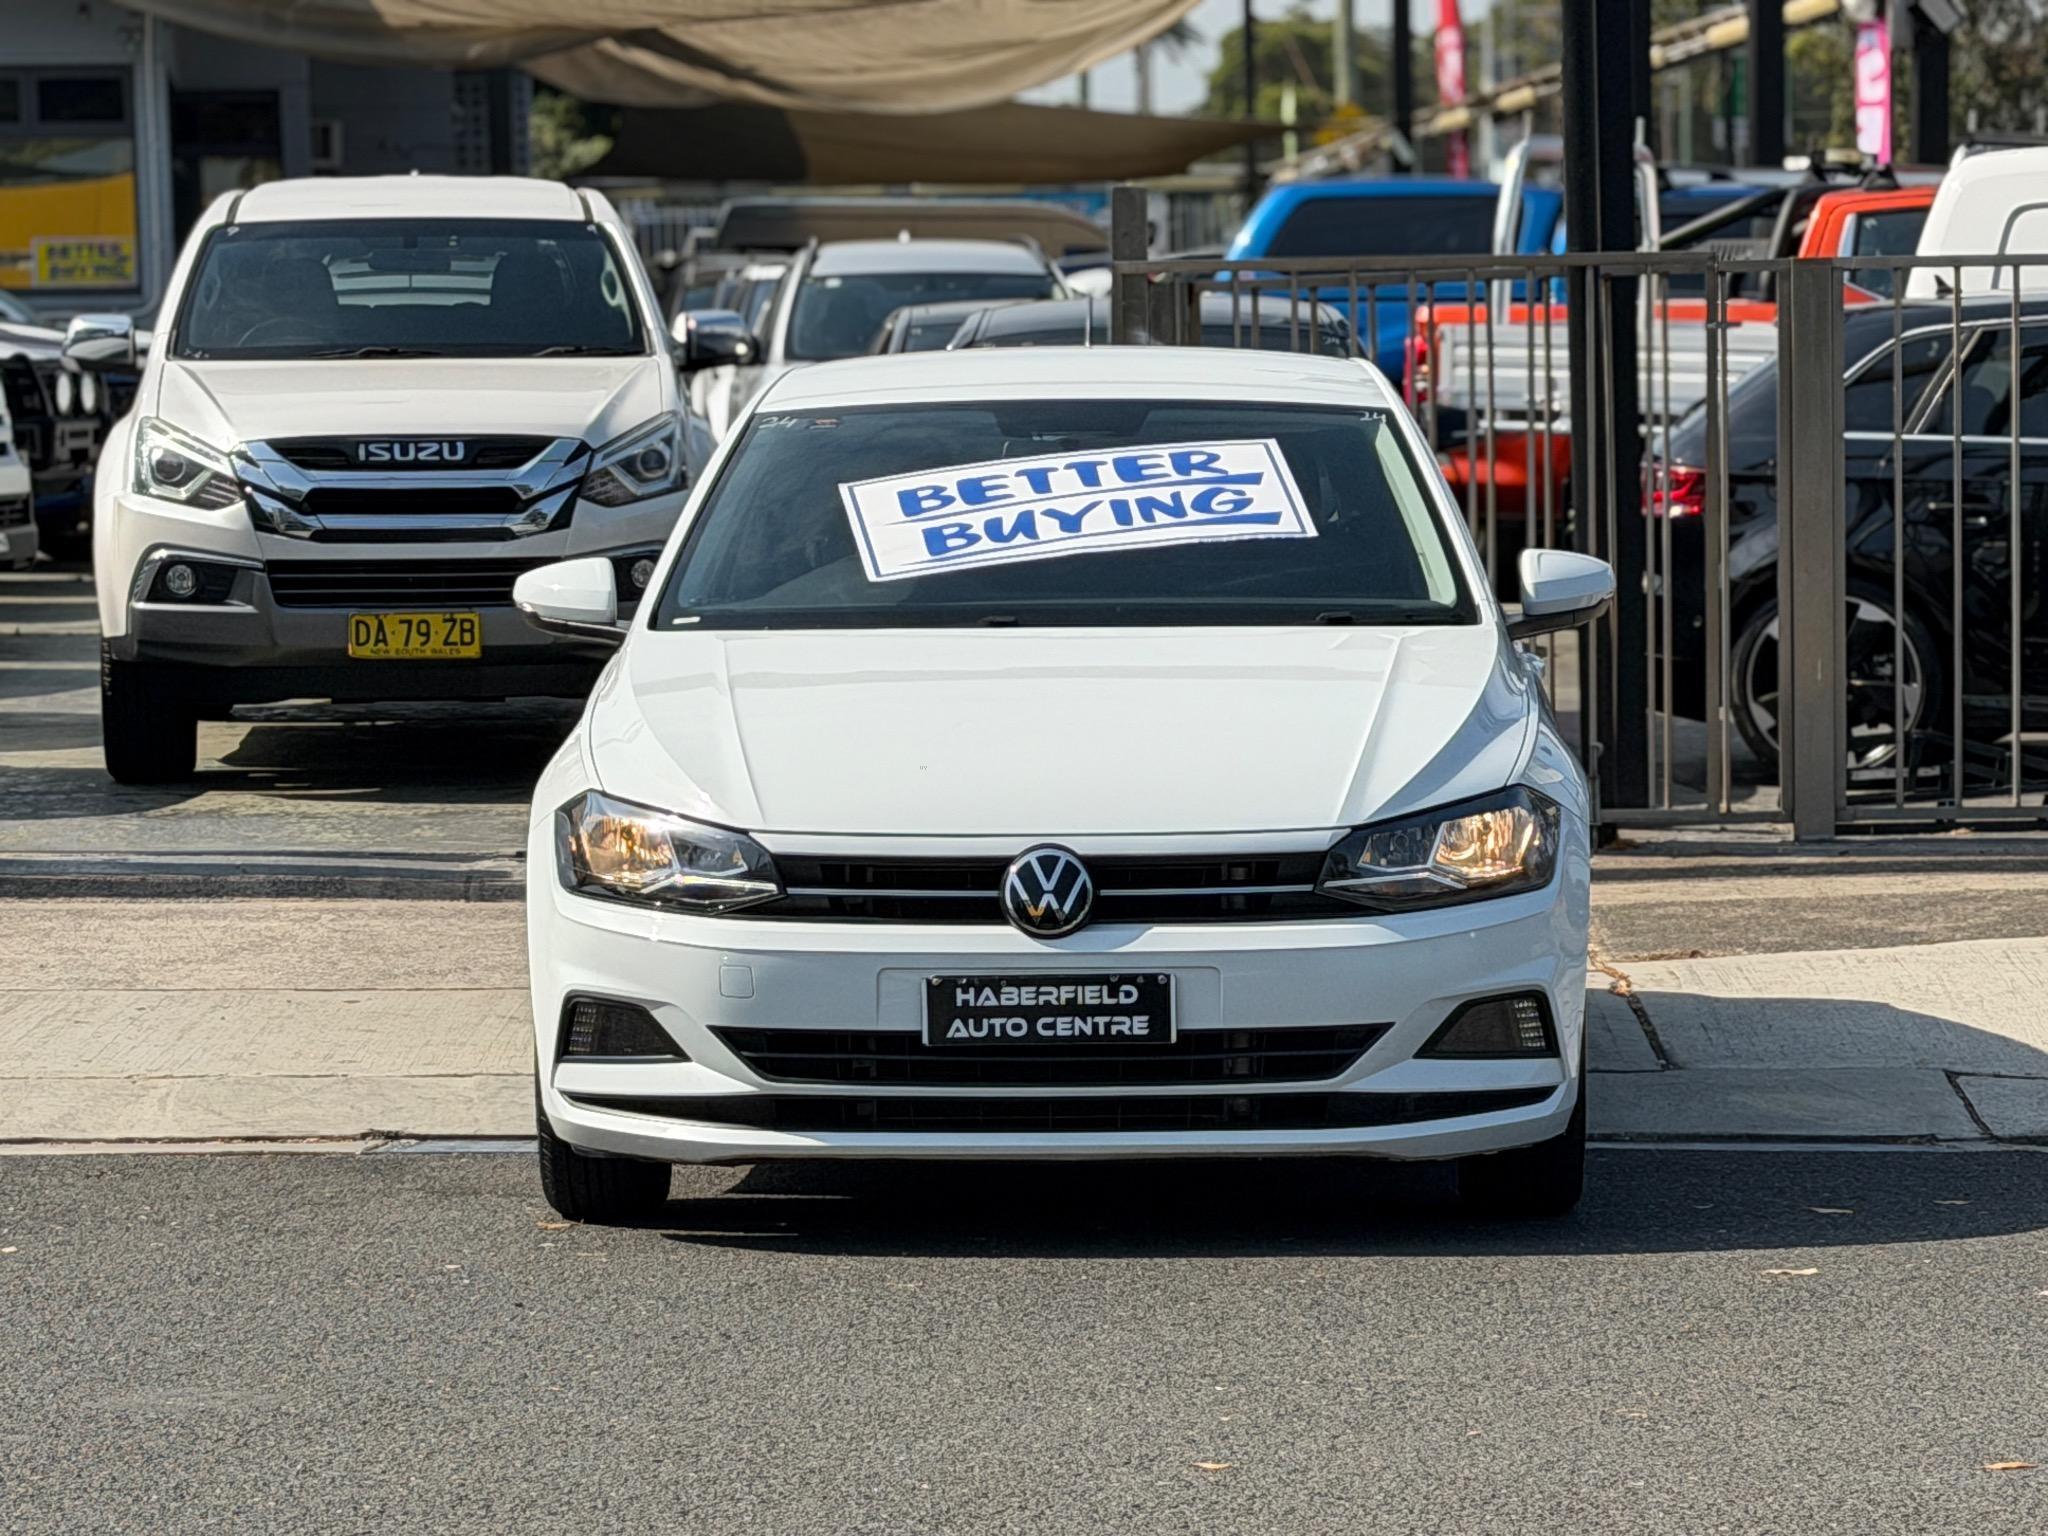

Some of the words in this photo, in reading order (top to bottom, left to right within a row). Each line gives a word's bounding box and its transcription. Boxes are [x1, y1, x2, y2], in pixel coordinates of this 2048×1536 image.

[358, 441, 464, 460] ISUZU
[897, 450, 1228, 517] BETTER
[922, 486, 1255, 557] BUYING
[956, 984, 1139, 1007] HABERFIELD
[946, 1017, 1028, 1038] AUTO
[1036, 1015, 1150, 1037] CENTRE
